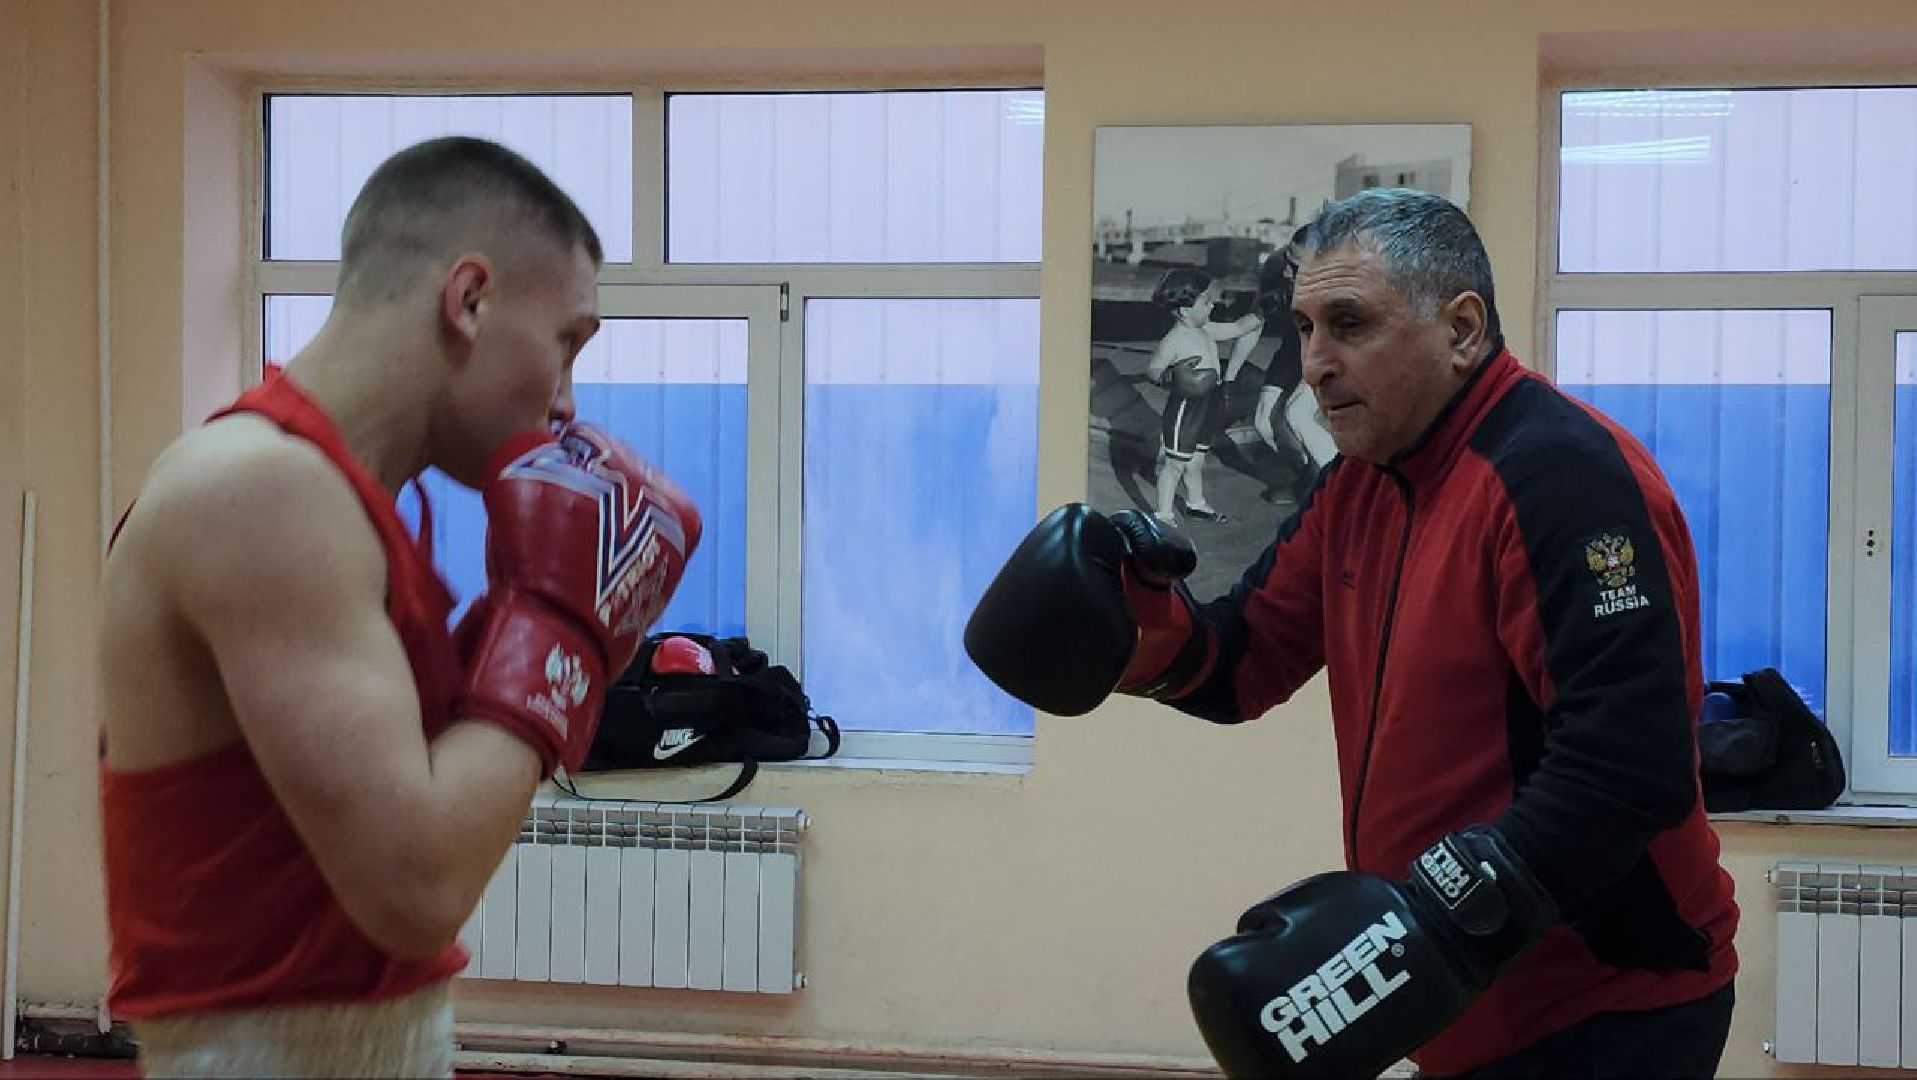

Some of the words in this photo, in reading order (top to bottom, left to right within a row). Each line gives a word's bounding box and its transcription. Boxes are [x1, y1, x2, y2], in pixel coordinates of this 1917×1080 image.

[1600, 585, 1636, 602] TEAM
[1594, 595, 1650, 617] RUSSIA
[660, 728, 695, 747] NIKE
[1261, 911, 1408, 1034] GREEN
[1278, 962, 1411, 1063] HILL
